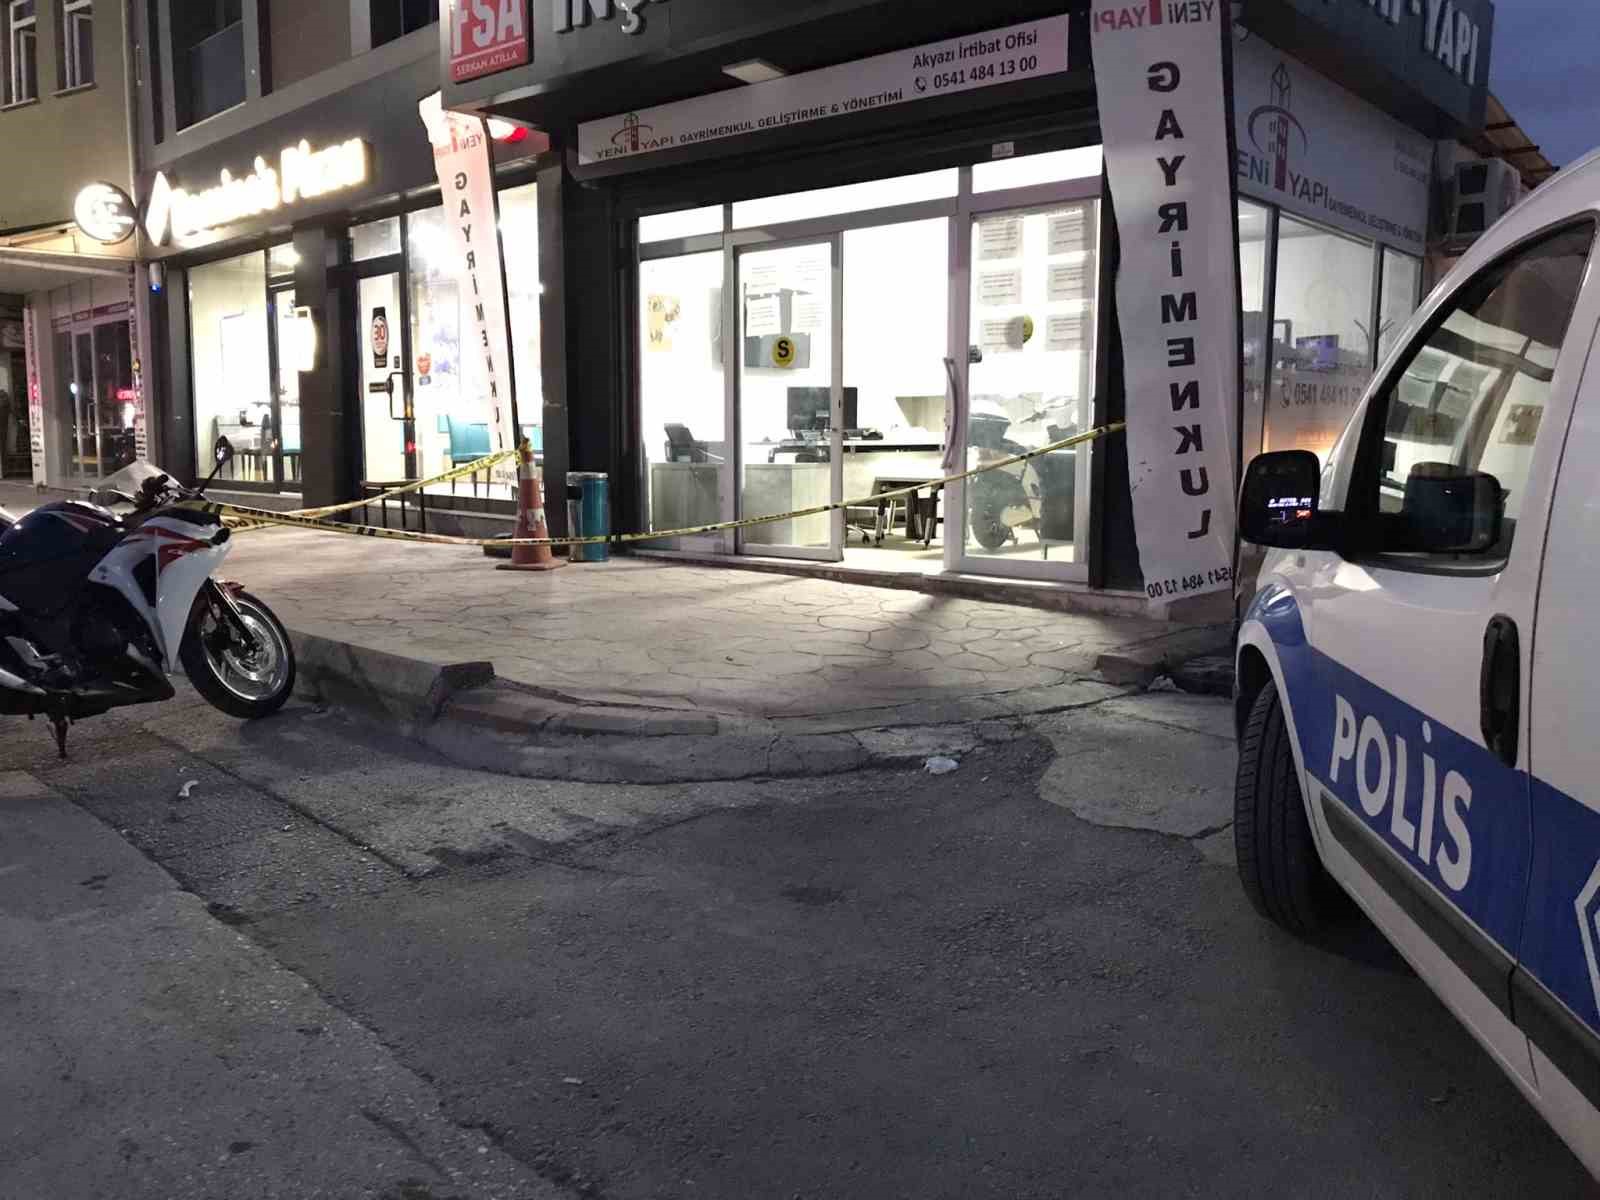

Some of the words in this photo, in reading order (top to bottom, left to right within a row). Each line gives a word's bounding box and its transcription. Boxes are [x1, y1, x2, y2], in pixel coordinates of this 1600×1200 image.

[450, 0, 523, 57] FSA
[934, 70, 965, 88] 0541
[970, 64, 995, 81] 484
[1000, 60, 1015, 75] 13
[1019, 55, 1037, 71] 00
[640, 136, 673, 149] YAPI
[830, 103, 840, 113] &
[1288, 169, 1329, 209] YAPI
[778, 340, 790, 358] S
